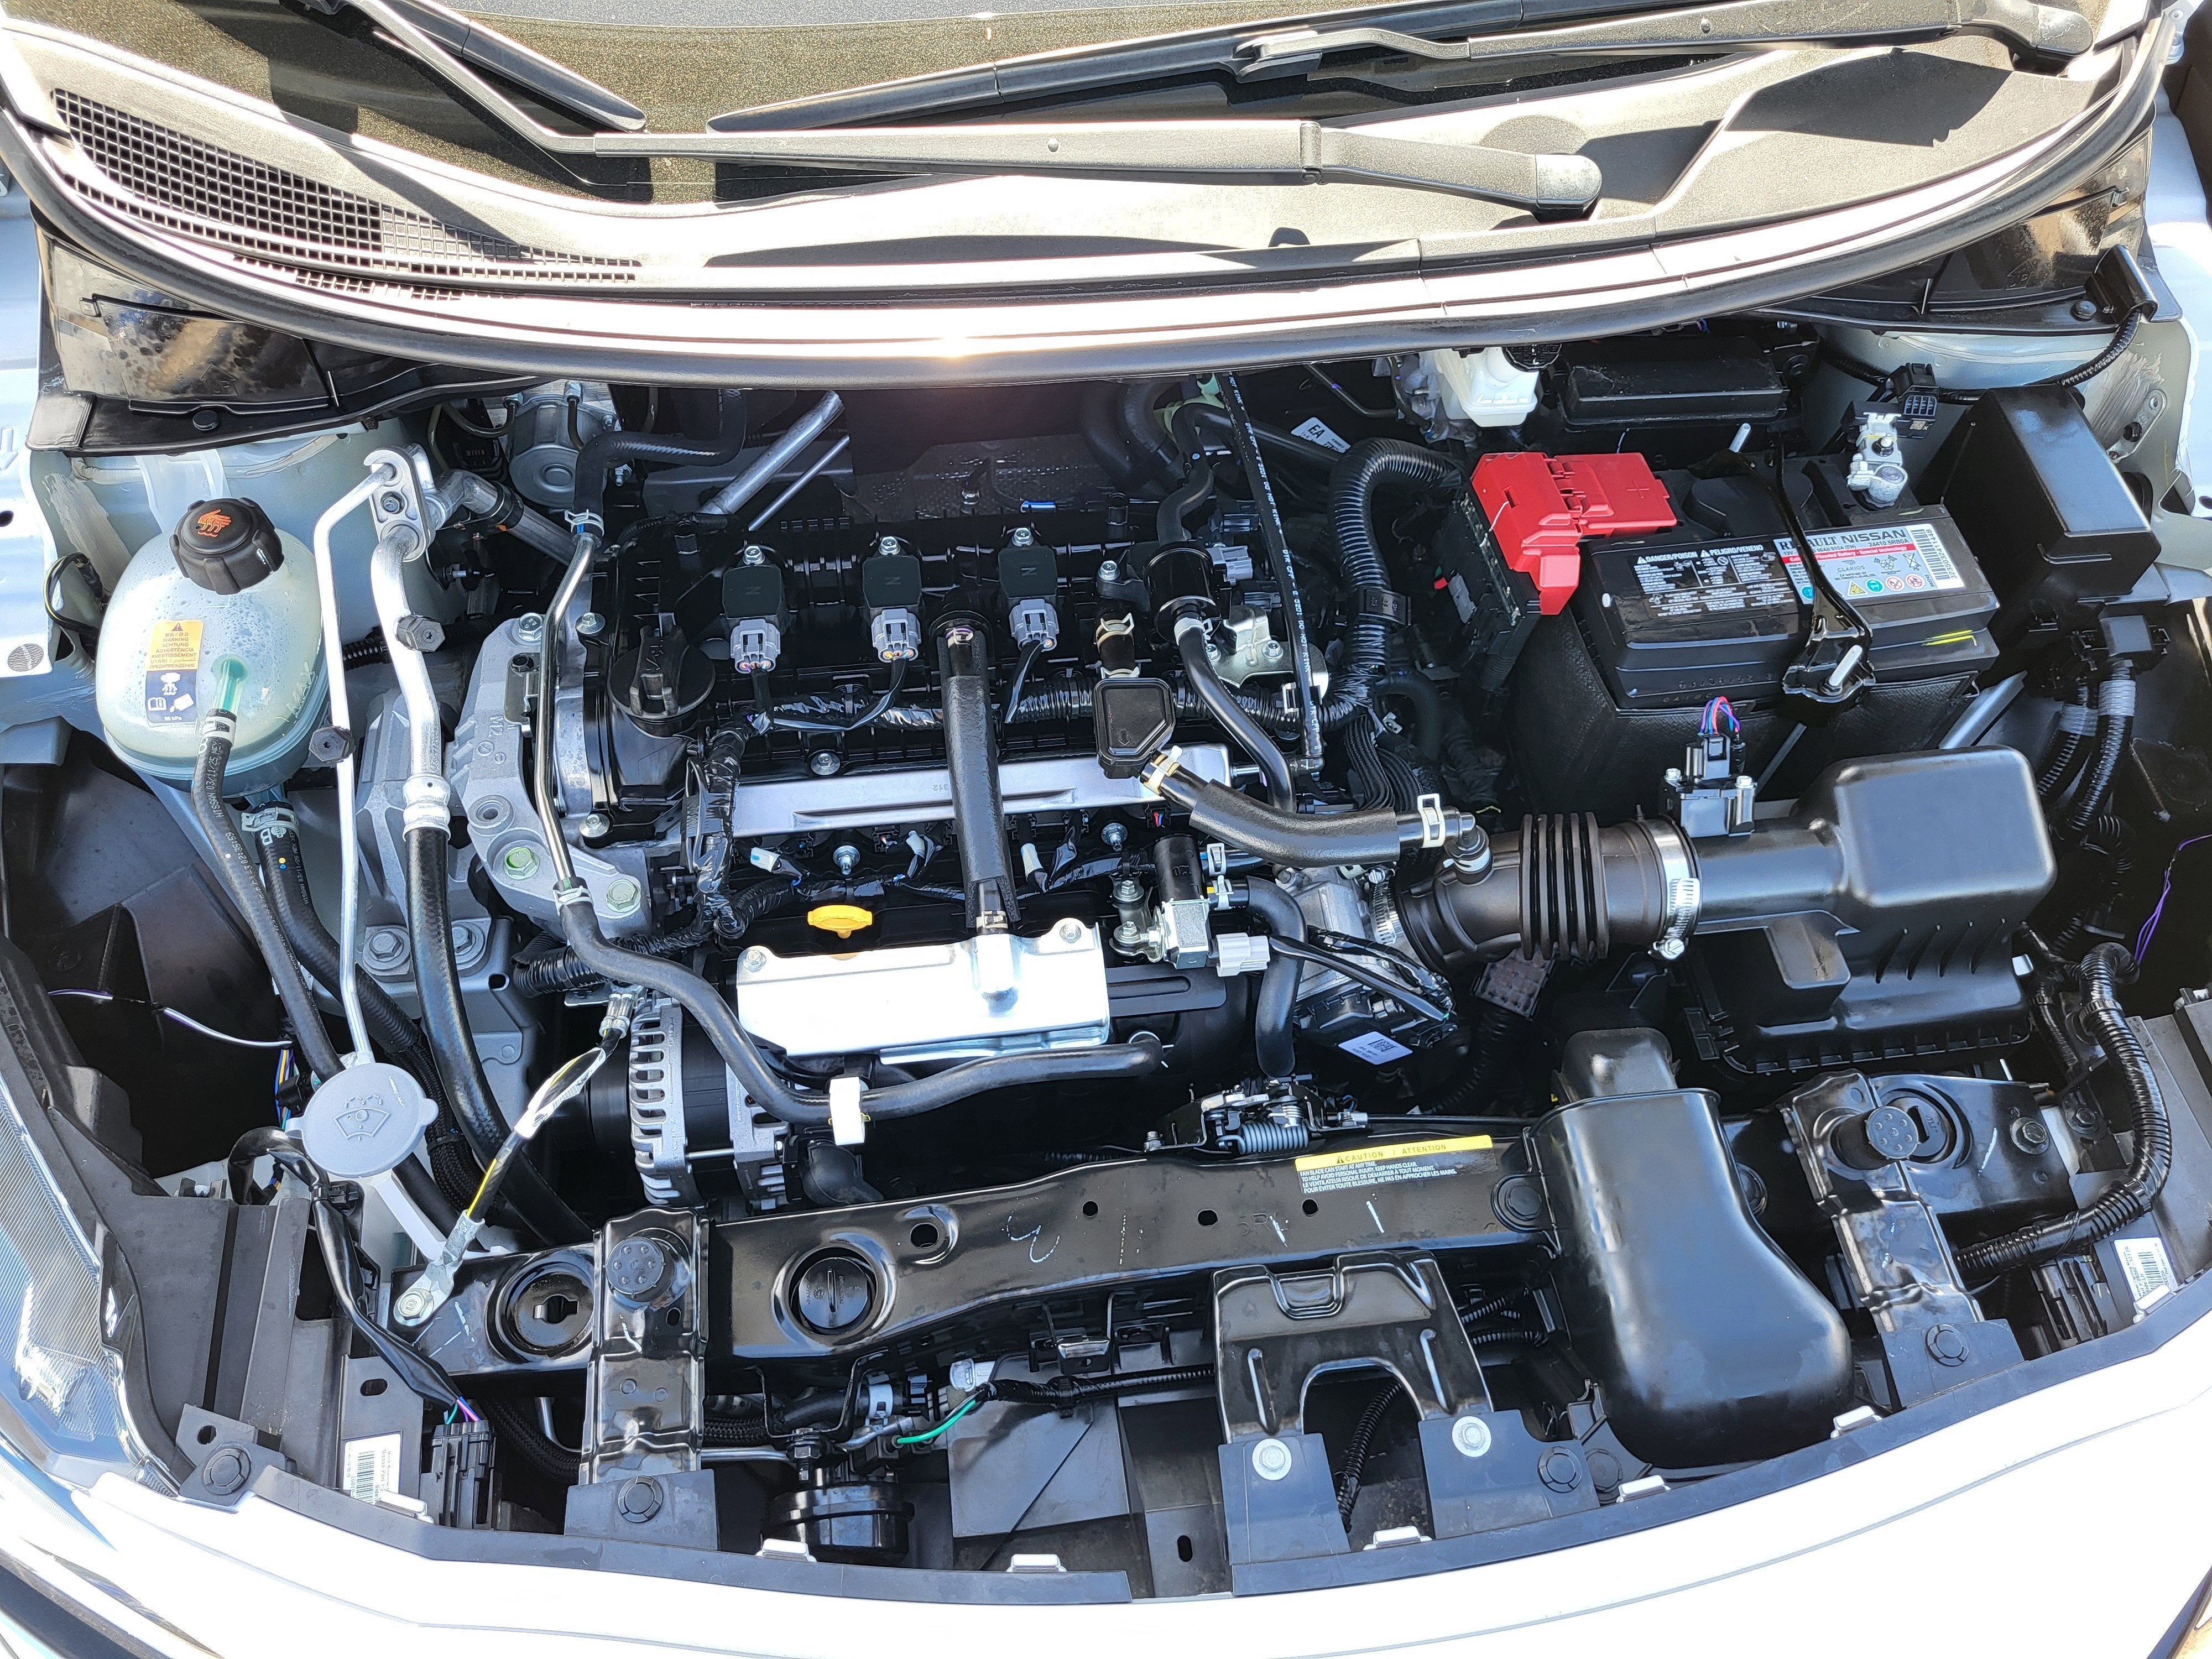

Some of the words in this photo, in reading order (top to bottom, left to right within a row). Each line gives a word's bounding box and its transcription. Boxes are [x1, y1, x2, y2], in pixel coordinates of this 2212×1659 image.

[1307, 424, 1325, 439] EA
[1272, 509, 1281, 526] KINK
[1840, 529, 1907, 544] NISSAN
[1646, 551, 1698, 563] DANGER/POISON
[1709, 544, 1764, 556] PELIGRO/VENENO
[206, 756, 219, 790] 03/11/25
[207, 792, 225, 818] NISSAN
[1344, 1151, 1384, 1162] CAUTION
[1401, 1143, 1447, 1155] ATTENTION
[1334, 1169, 1358, 1177] PERSONAL
[1401, 1171, 1431, 1180] APPROCHER
[1308, 1177, 1342, 1187] VENTILATEUR
